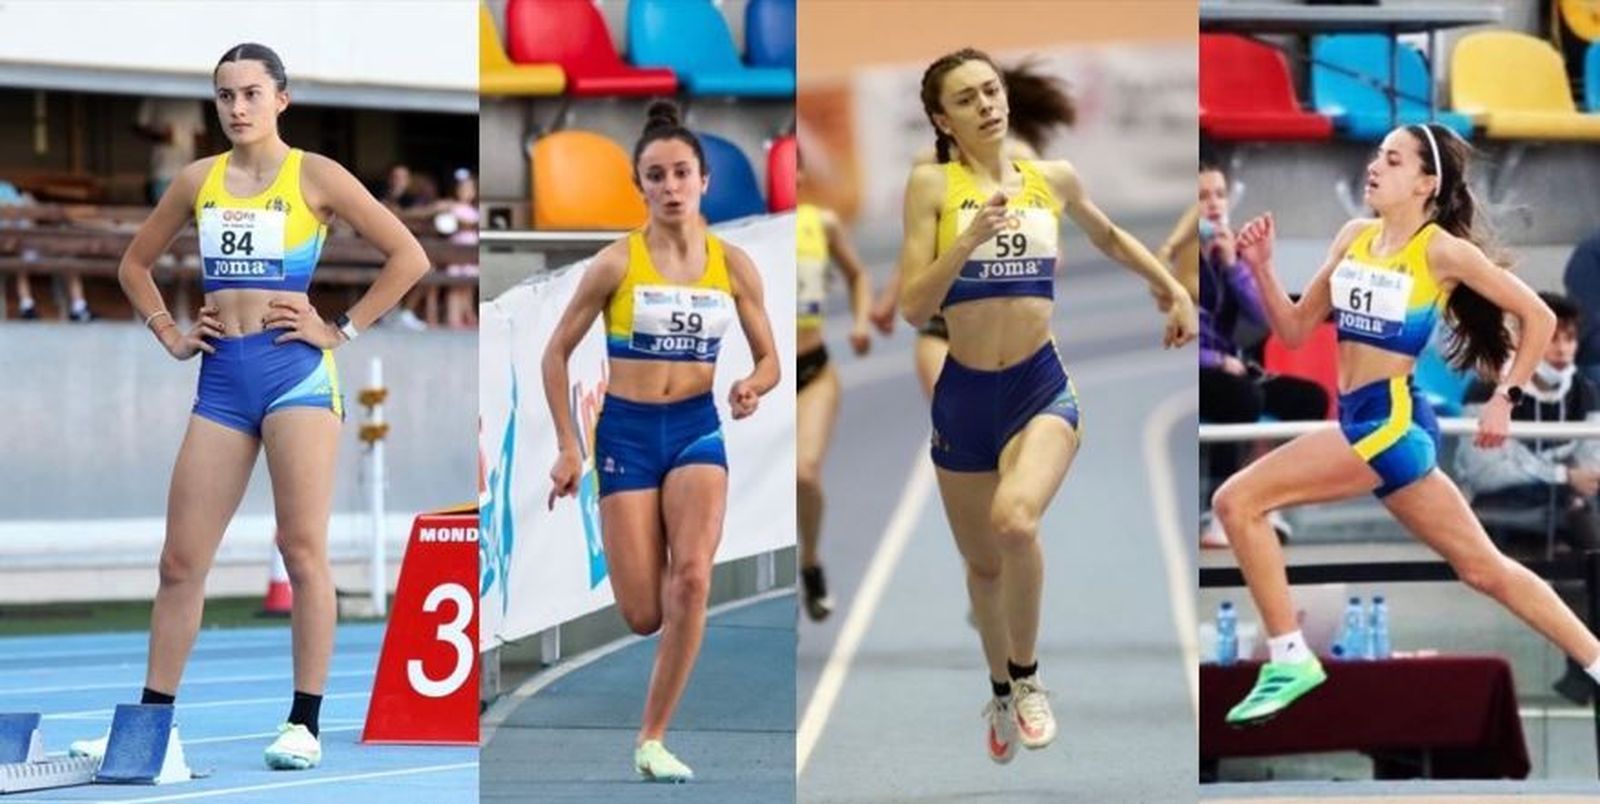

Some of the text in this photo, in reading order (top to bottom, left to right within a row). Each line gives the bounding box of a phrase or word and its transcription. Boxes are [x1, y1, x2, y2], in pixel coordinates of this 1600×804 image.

[221, 230, 254, 256] 84
[996, 233, 1027, 258] 59
[1349, 287, 1373, 314] 61
[668, 311, 703, 334] 59
[419, 527, 479, 542] MOND
[407, 582, 475, 698] 3
